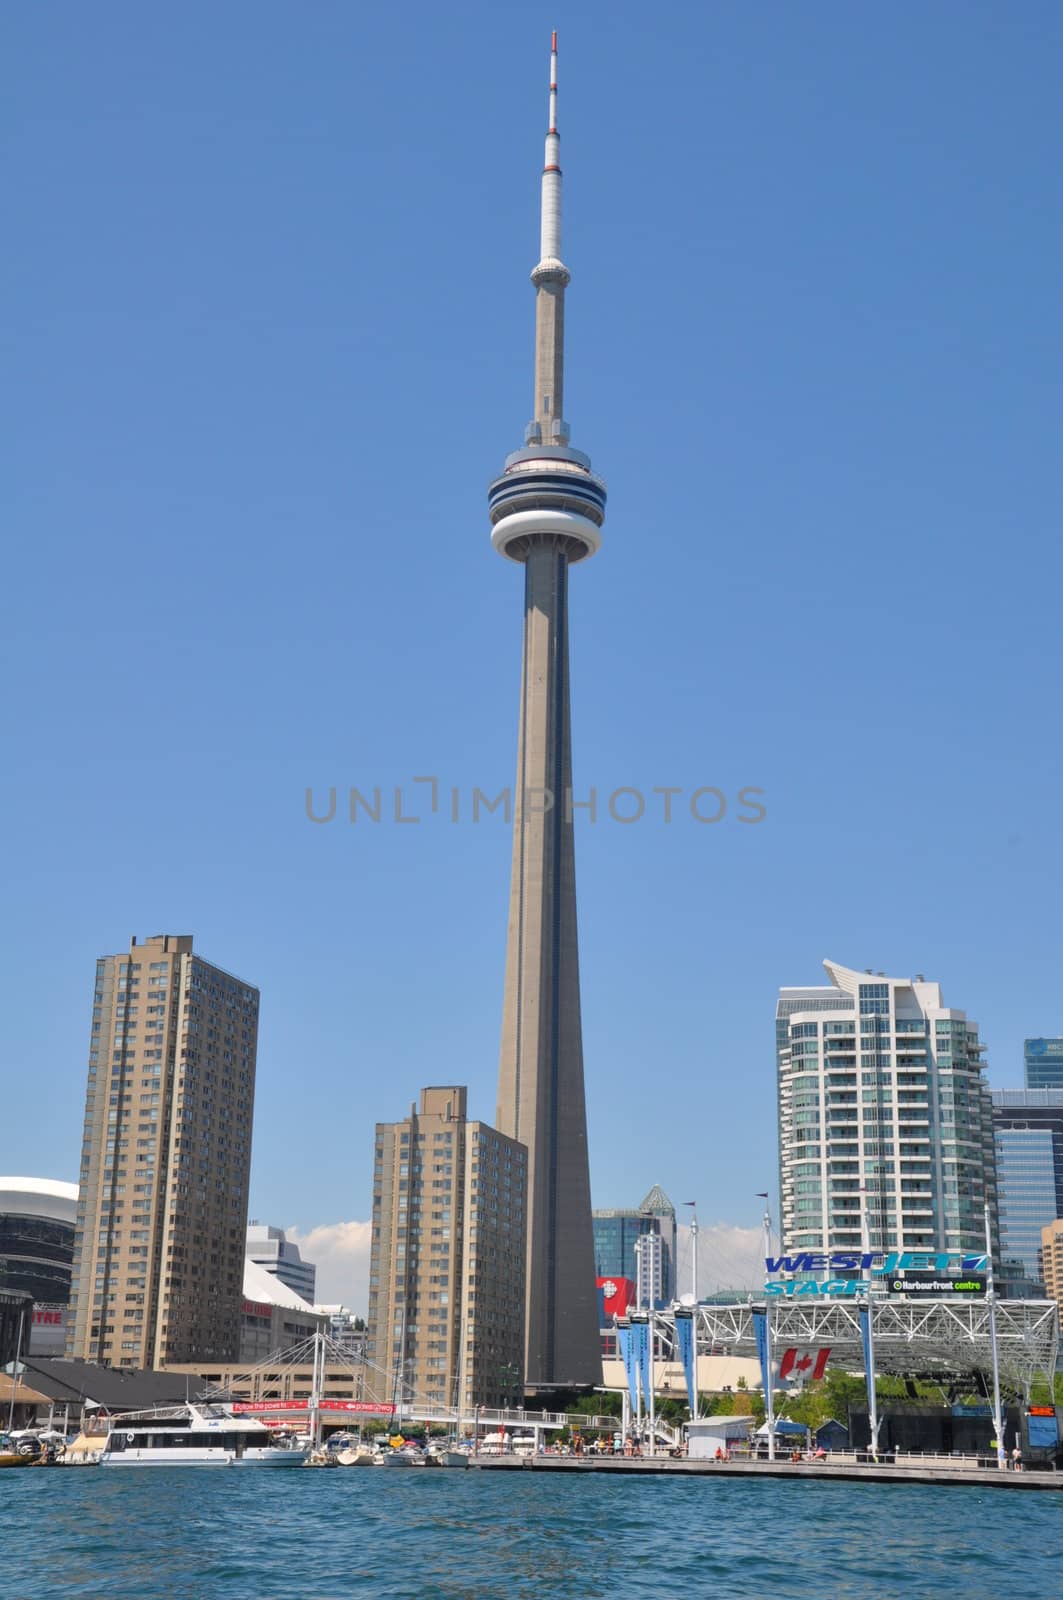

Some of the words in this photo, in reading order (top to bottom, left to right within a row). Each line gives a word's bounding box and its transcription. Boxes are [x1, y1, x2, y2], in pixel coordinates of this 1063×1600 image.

[765, 1253, 962, 1275] WESTJET
[763, 1280, 870, 1296] STAGE
[902, 1281, 954, 1290] Harbourfront
[954, 1281, 981, 1290] centre
